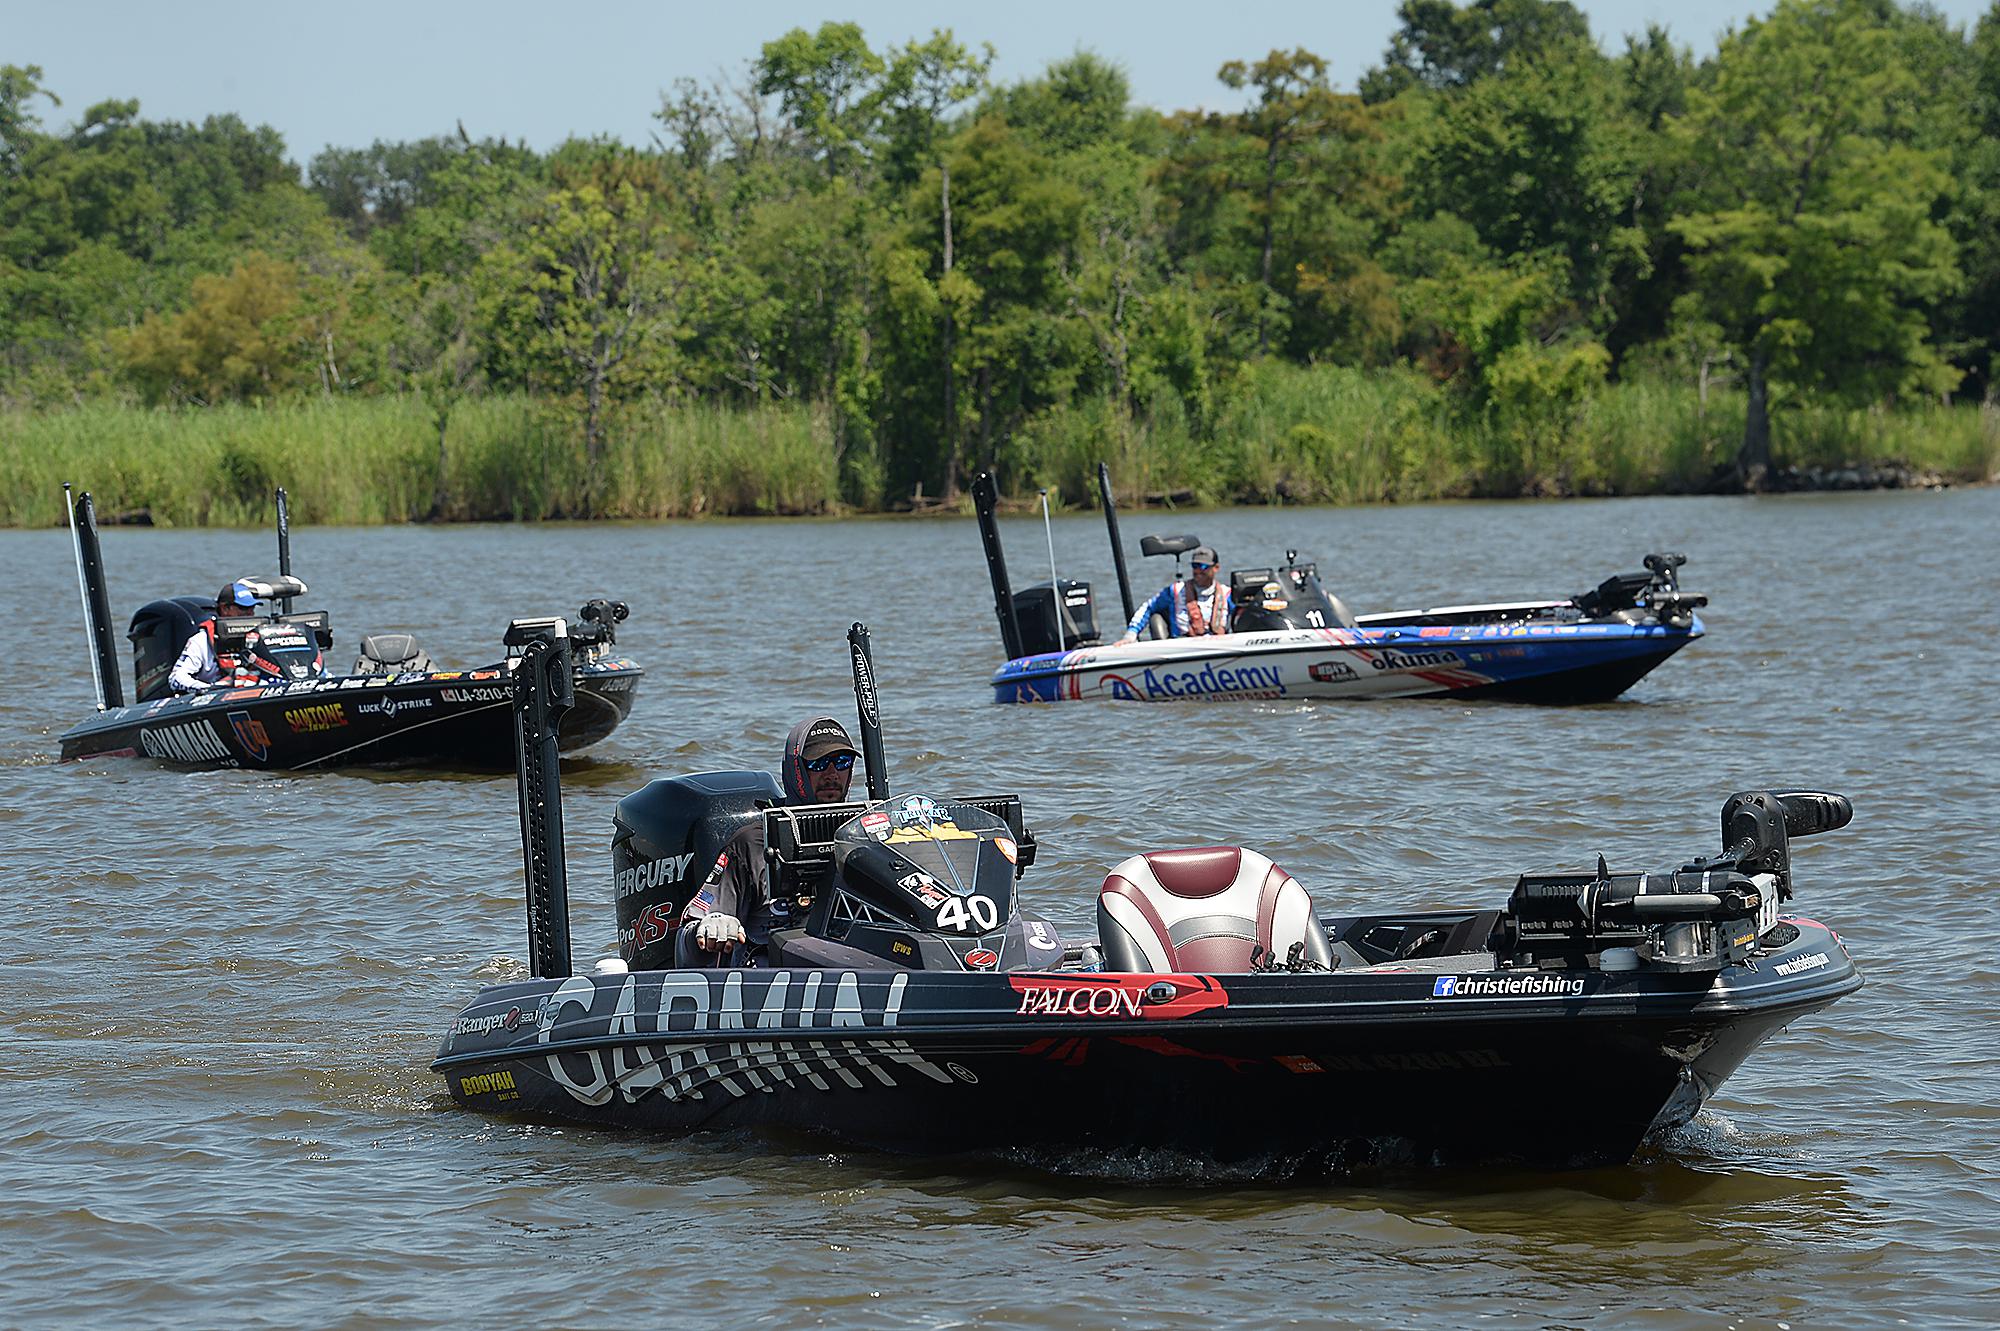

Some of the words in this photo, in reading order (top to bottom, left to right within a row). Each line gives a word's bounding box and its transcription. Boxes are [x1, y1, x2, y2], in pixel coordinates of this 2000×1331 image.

[1306, 610, 1325, 628] 11
[1371, 650, 1458, 670] okuma
[854, 653, 876, 719] POWER-POLE
[1144, 662, 1287, 699] Academy
[358, 704, 380, 713] LUCK
[398, 699, 432, 710] STRIKE
[457, 686, 513, 702] LA-3210-G
[285, 703, 348, 732] SANTONE
[153, 720, 231, 761] YAMAHA
[936, 895, 998, 931] 40
[619, 928, 636, 946] Pro
[1455, 975, 1585, 996] christiefishing
[1017, 987, 1144, 1016] FALCON
[456, 1013, 507, 1037] Ranger
[538, 971, 954, 1106] GARMIN
[461, 1071, 516, 1096] BOOYAH
